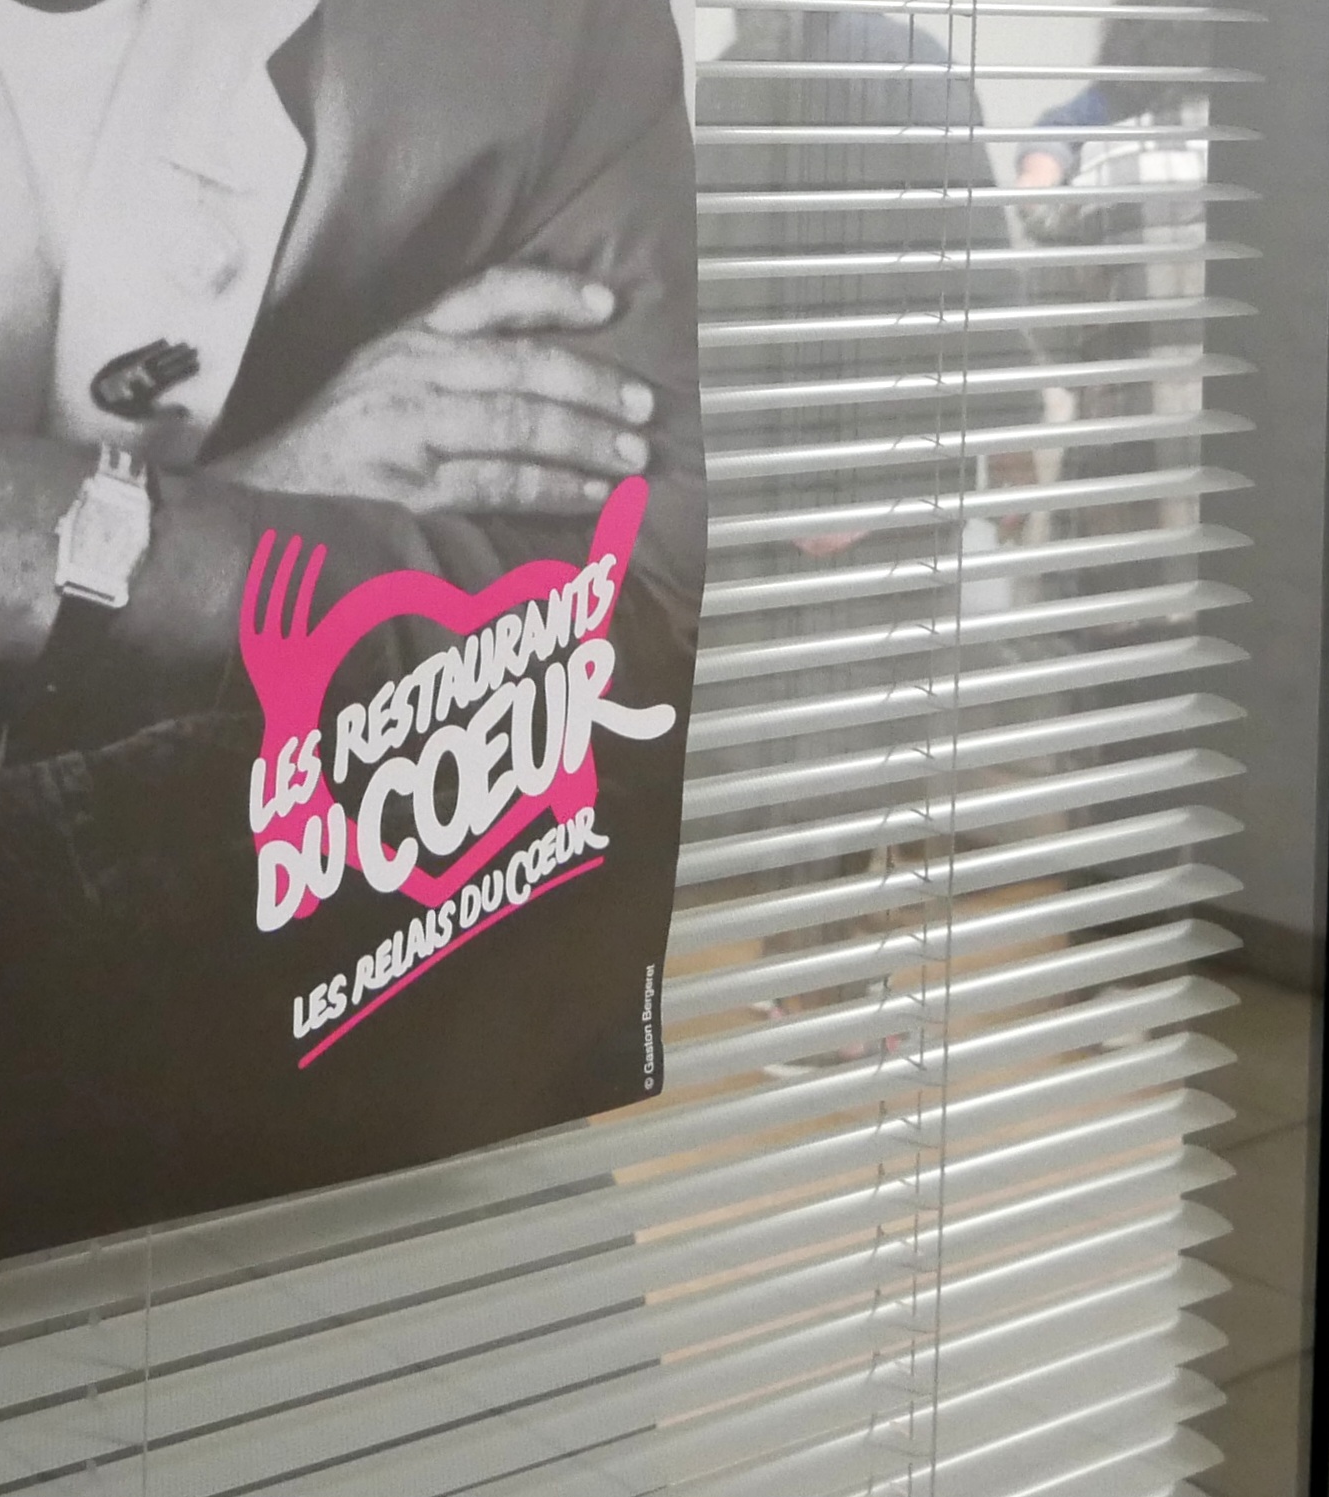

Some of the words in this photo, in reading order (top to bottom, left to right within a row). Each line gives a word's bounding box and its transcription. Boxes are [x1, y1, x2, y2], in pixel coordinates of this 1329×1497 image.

[250, 729, 322, 833] LES
[333, 553, 617, 785] RESTAURANTS
[256, 802, 347, 932] DU
[292, 974, 347, 1038] LES
[352, 900, 456, 1003] RELAIS
[459, 872, 504, 928] DU
[642, 963, 655, 1021] Bergeret
[644, 1023, 654, 1074] Gaston
